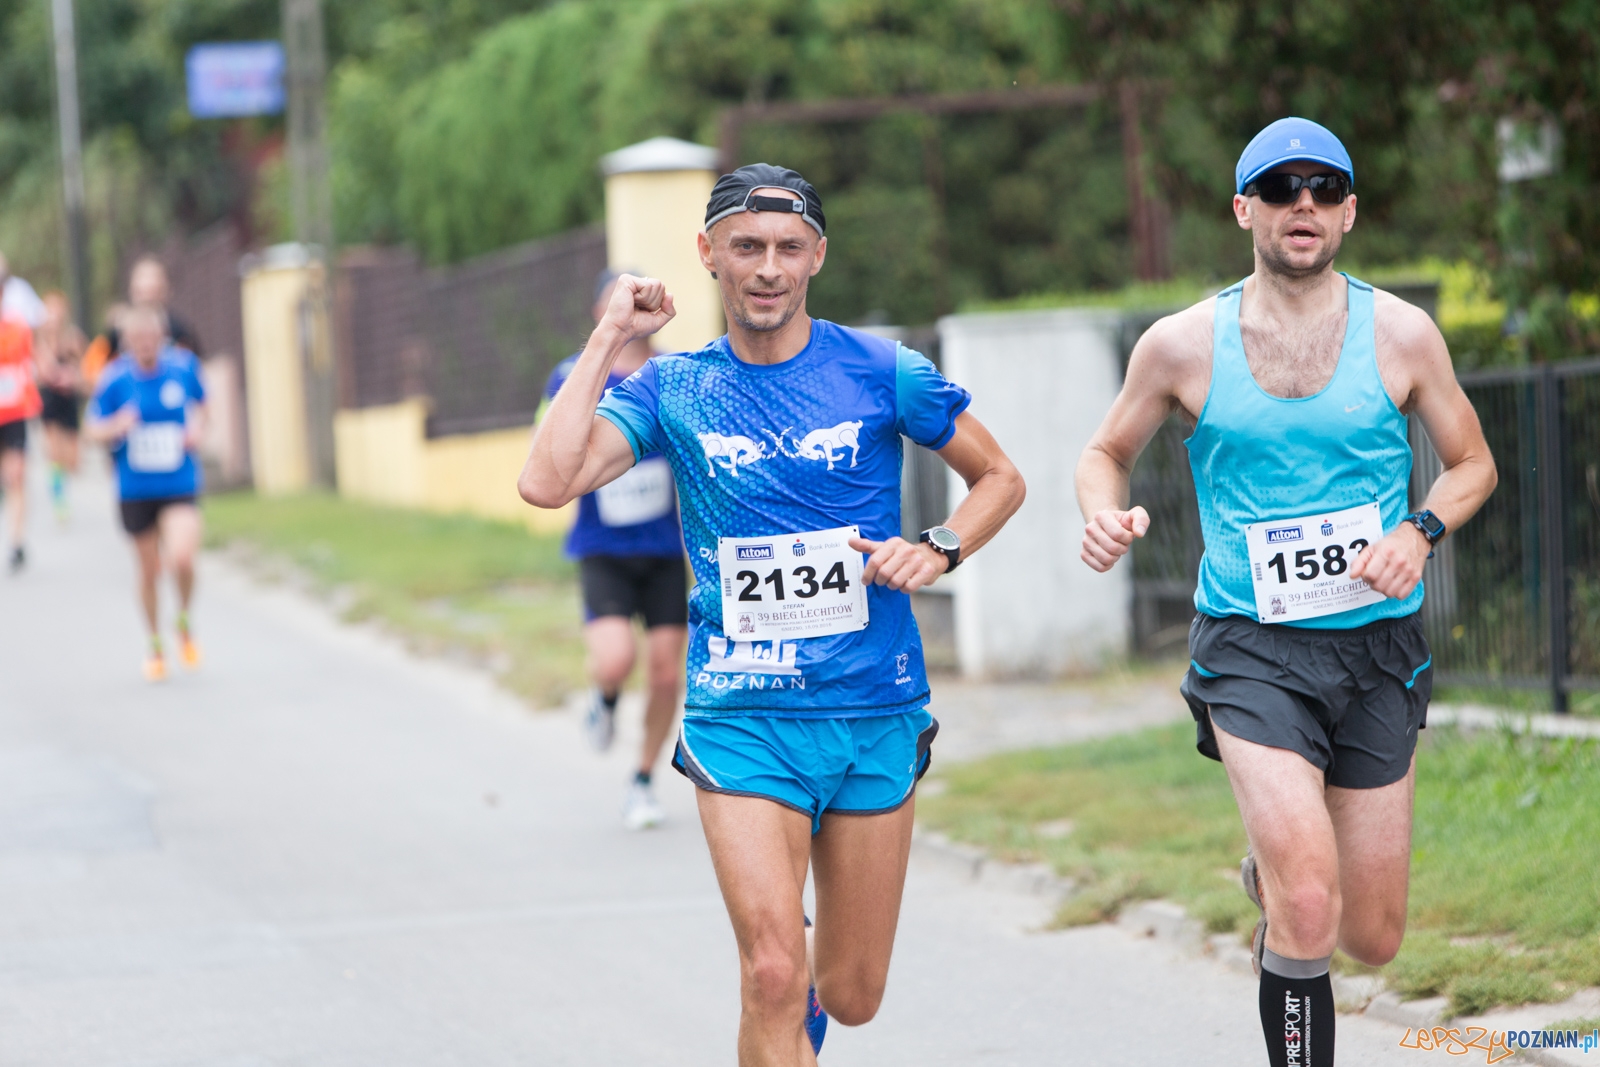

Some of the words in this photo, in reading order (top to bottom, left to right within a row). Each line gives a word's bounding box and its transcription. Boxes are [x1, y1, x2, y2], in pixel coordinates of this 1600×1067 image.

[809, 544, 823, 552] Bank
[824, 541, 841, 550] Polski
[736, 561, 850, 602] 2134
[1313, 580, 1336, 588] TOMASZ
[1288, 592, 1301, 603] 39
[1303, 588, 1328, 600] BIEG
[757, 612, 770, 622] 39
[772, 611, 798, 621] BIEG
[800, 602, 854, 619] LECHITÓW
[695, 672, 806, 690] POZNAŃ
